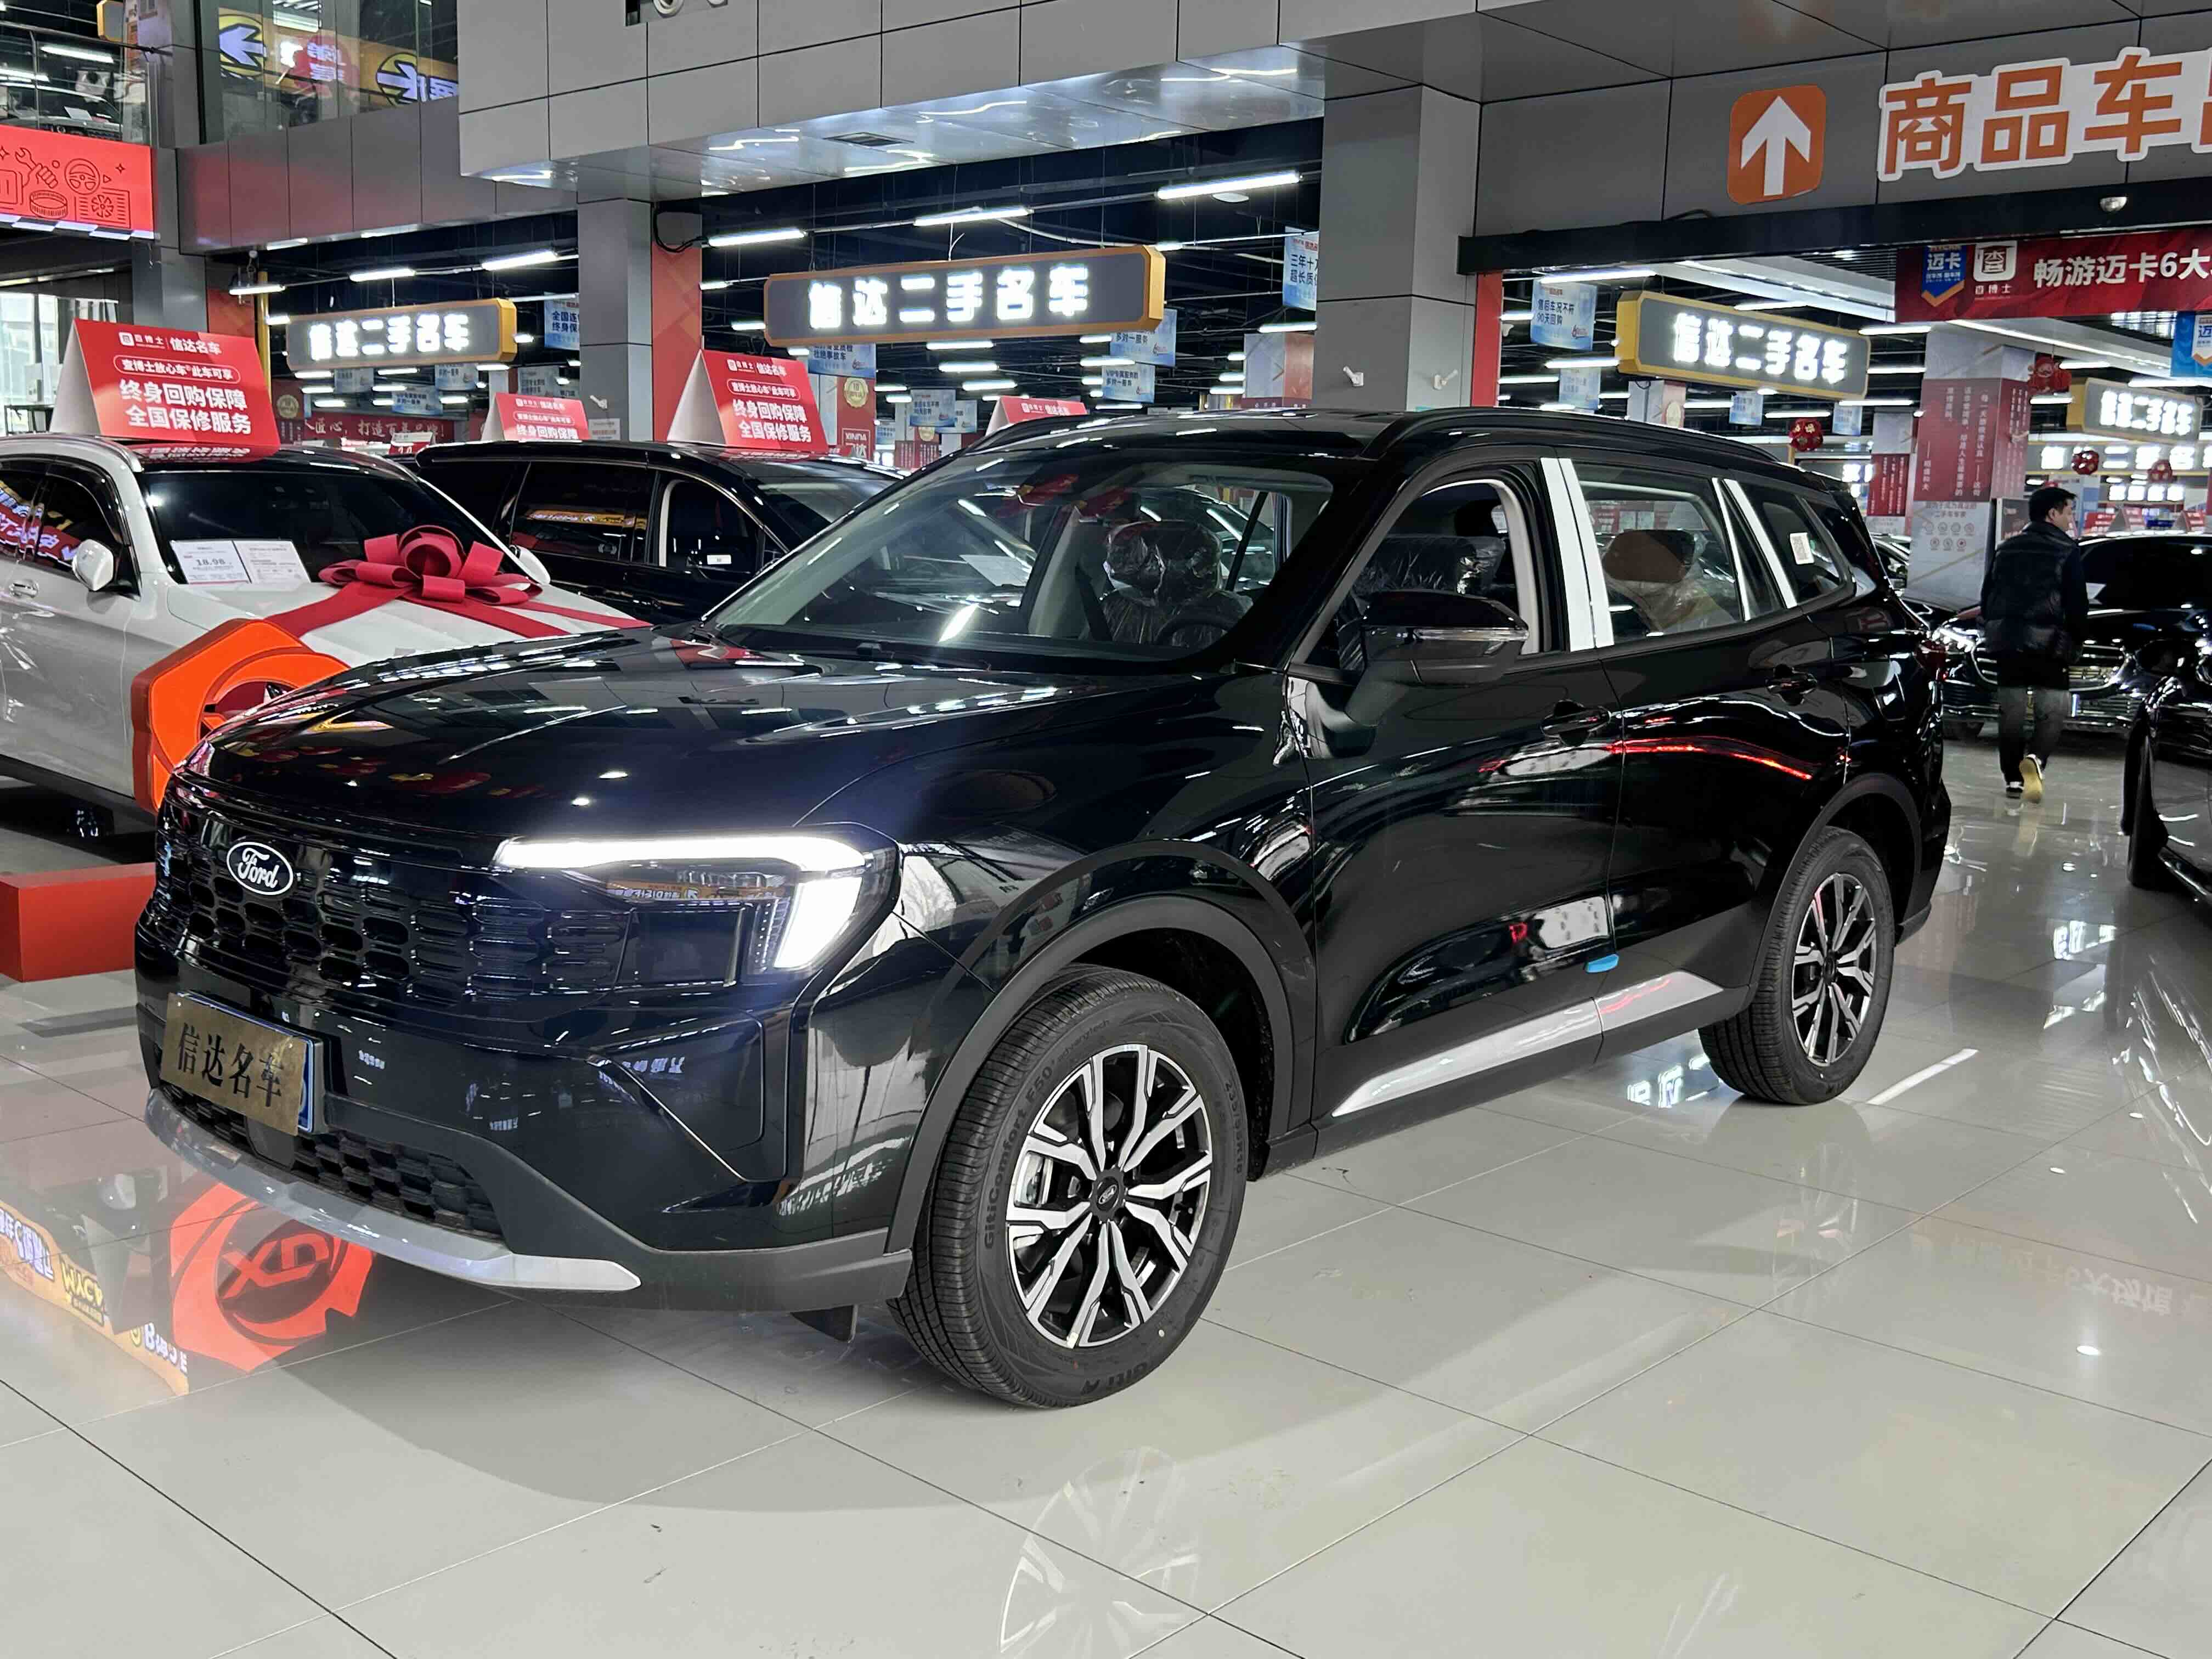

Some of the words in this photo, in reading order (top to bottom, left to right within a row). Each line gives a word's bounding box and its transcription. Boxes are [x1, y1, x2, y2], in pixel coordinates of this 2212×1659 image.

[1883, 54, 2212, 176] 商品车
[1927, 252, 1962, 270] 迈卡
[2033, 248, 2212, 288] 畅游迈卡6大
[1290, 269, 1318, 285] 超长质
[1975, 284, 2012, 295] 查博士
[552, 311, 579, 323] 全国连
[170, 337, 222, 355] 信达名车
[119, 379, 248, 410] 终身回购保障
[125, 404, 251, 435] 全国保修服务
[732, 399, 808, 424] 终身回购保障
[738, 420, 812, 443] 全国保修服务
[236, 847, 280, 888] Ford
[178, 1022, 283, 1107] 信达名车
